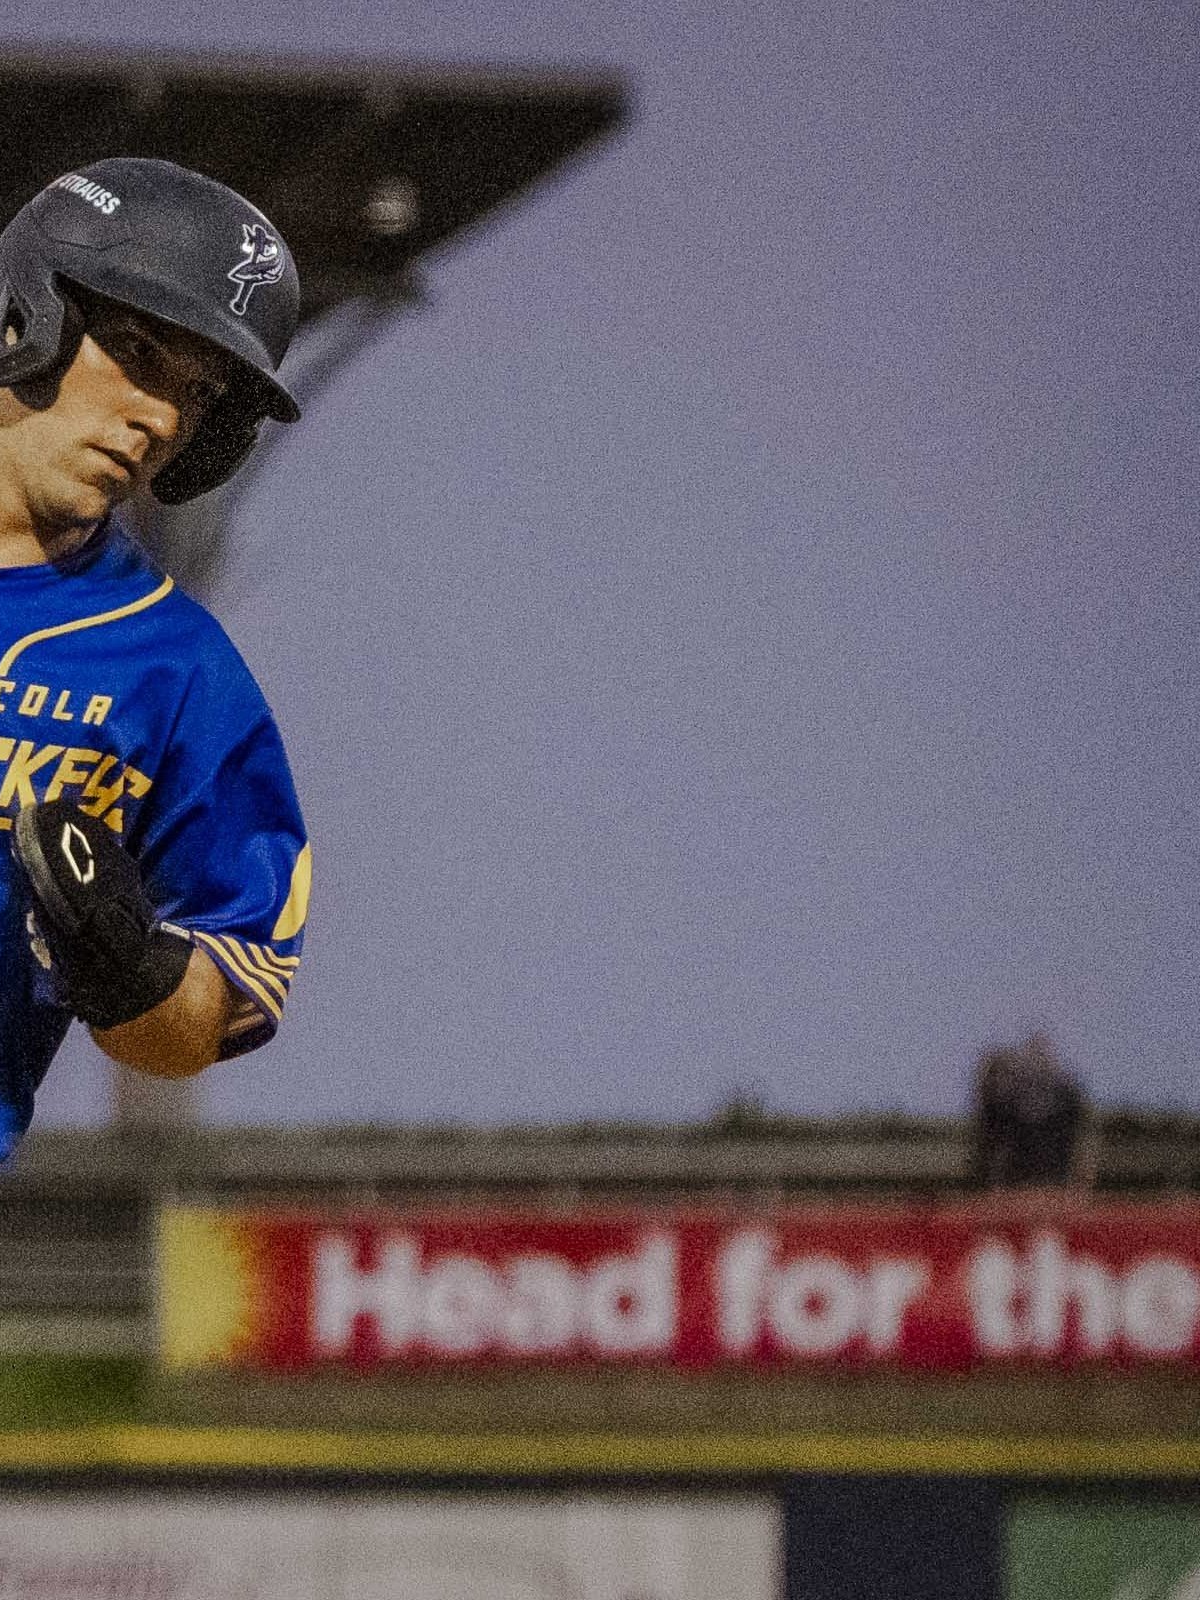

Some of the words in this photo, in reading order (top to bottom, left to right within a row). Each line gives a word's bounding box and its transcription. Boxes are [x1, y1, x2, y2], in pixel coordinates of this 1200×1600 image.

[311, 1231, 678, 1353] Head
[717, 1228, 930, 1353] for
[970, 1230, 1200, 1353] the
